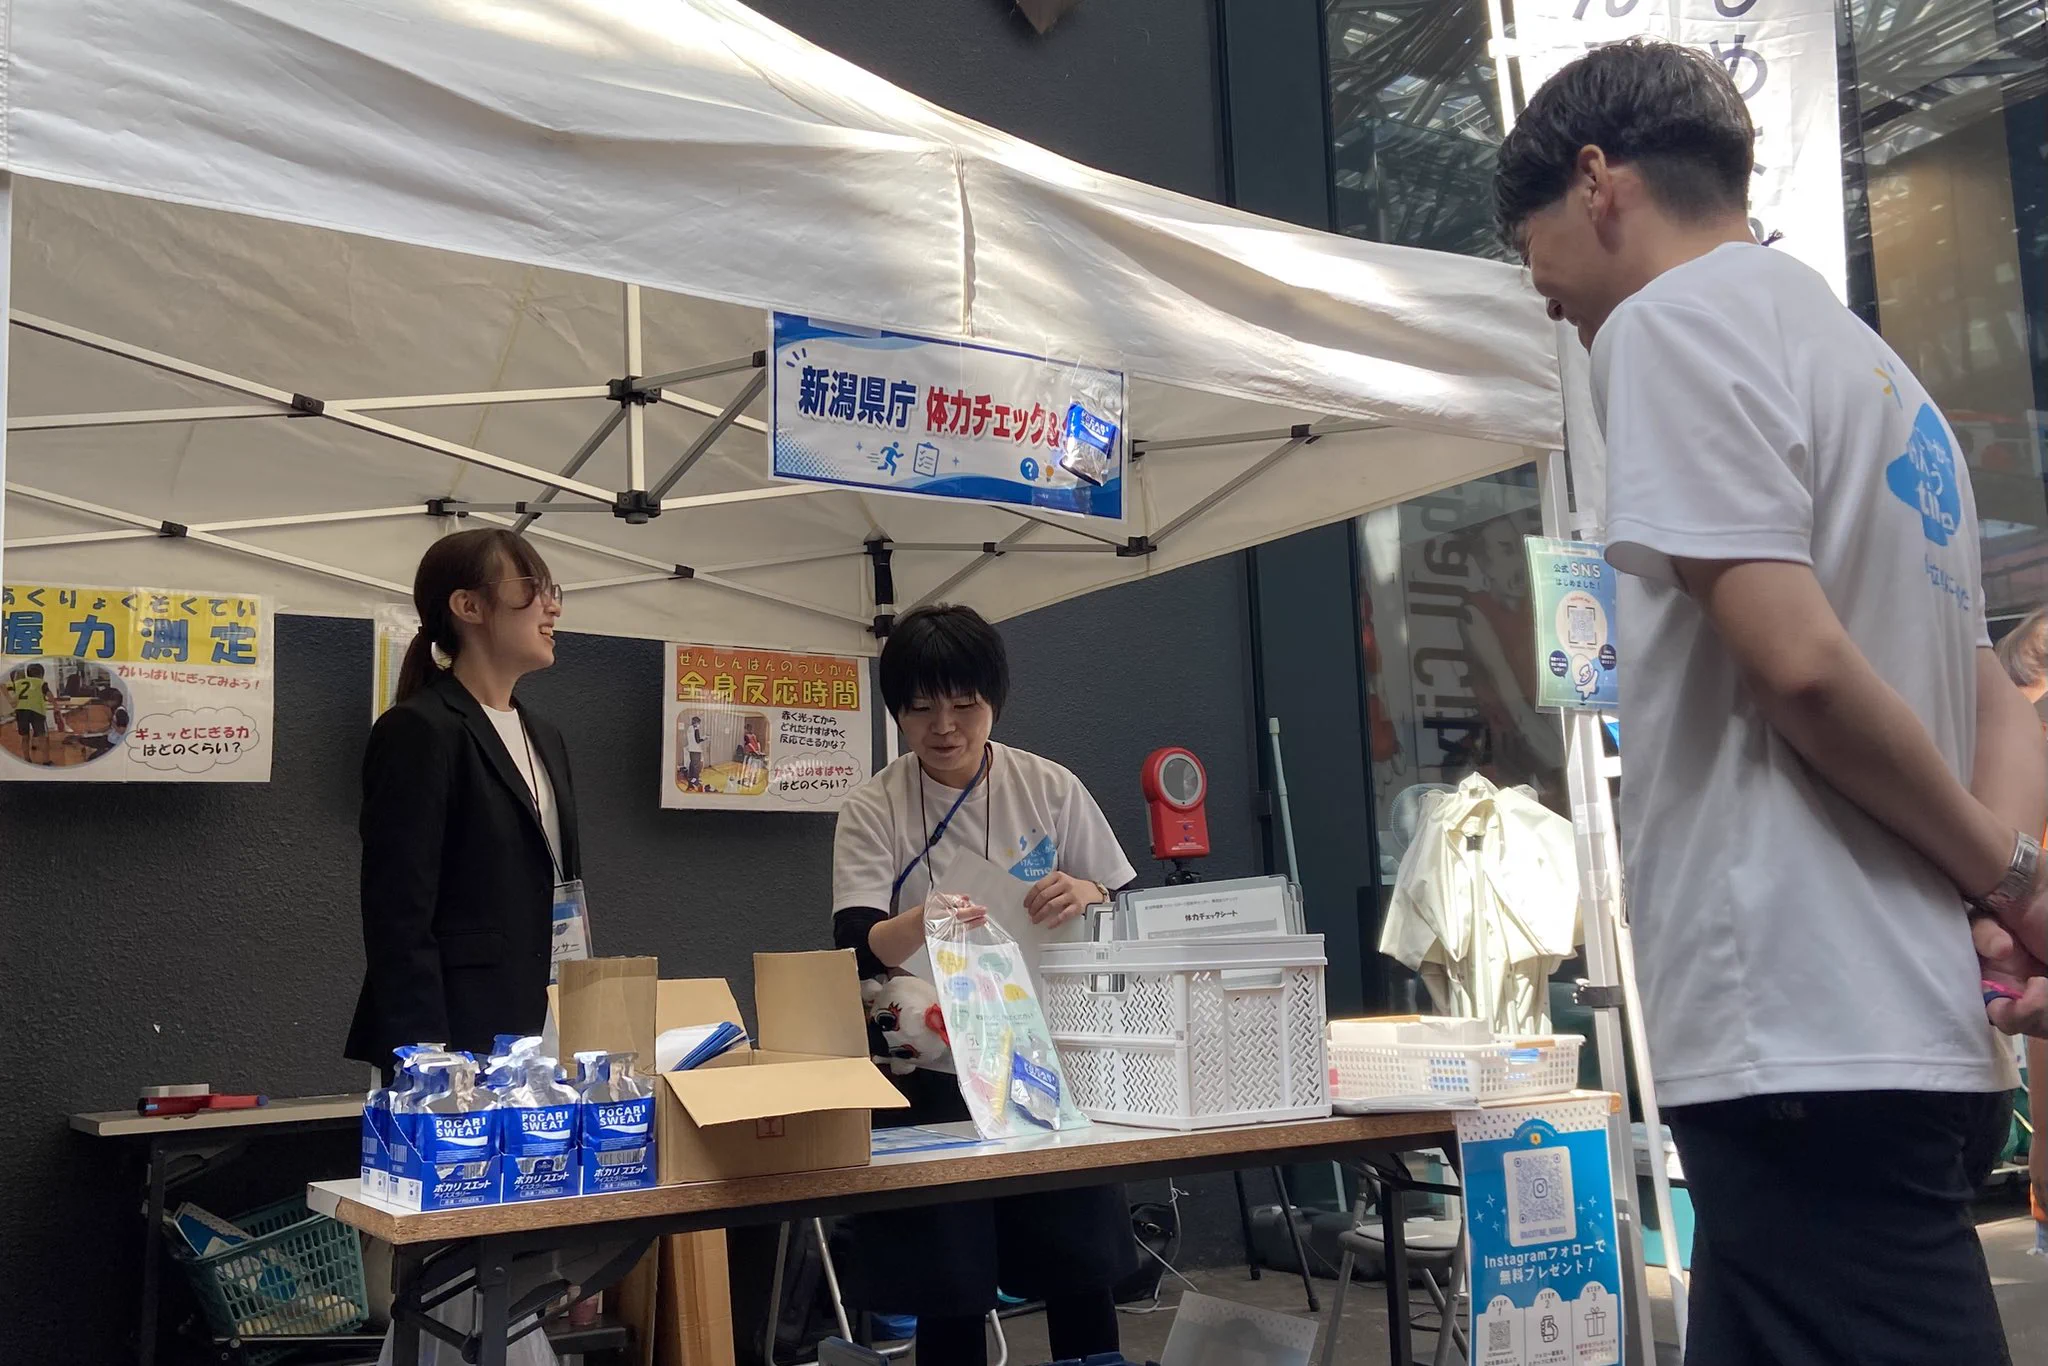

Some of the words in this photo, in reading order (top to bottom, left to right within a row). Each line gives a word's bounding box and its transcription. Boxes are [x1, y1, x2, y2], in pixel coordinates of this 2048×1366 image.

[799, 366, 917, 428] 新潟県庁
[926, 385, 1067, 449] 体力チェック&
[3, 611, 256, 664] 握力測定
[678, 671, 859, 709] 全身反応時間
[781, 710, 837, 726] 赤く光ってから
[135, 725, 249, 740] ギュッとにぎる力
[780, 722, 846, 739] どれだけすばやく
[143, 742, 241, 757] はどのくらい？
[779, 779, 848, 791] はどのくらい？
[1185, 910, 1238, 921] 体力チェックシート
[522, 1111, 569, 1122] POCARI
[599, 1105, 646, 1117] POCARI
[436, 1117, 486, 1129] POCARI
[522, 1120, 564, 1131] SWEAT
[600, 1114, 642, 1126] SWEAT
[436, 1126, 481, 1137] SWEAT
[594, 1167, 620, 1177] ポカリ
[621, 1165, 647, 1175] スエット
[514, 1174, 541, 1185] ポカリ
[542, 1172, 569, 1183] スエット
[433, 1182, 461, 1193] ポカリ
[463, 1180, 491, 1190] スエット
[1484, 1240, 1606, 1268] Instagramフォローで
[1586, 1285, 1601, 1293] STEP
[1545, 1300, 1550, 1309] 2
